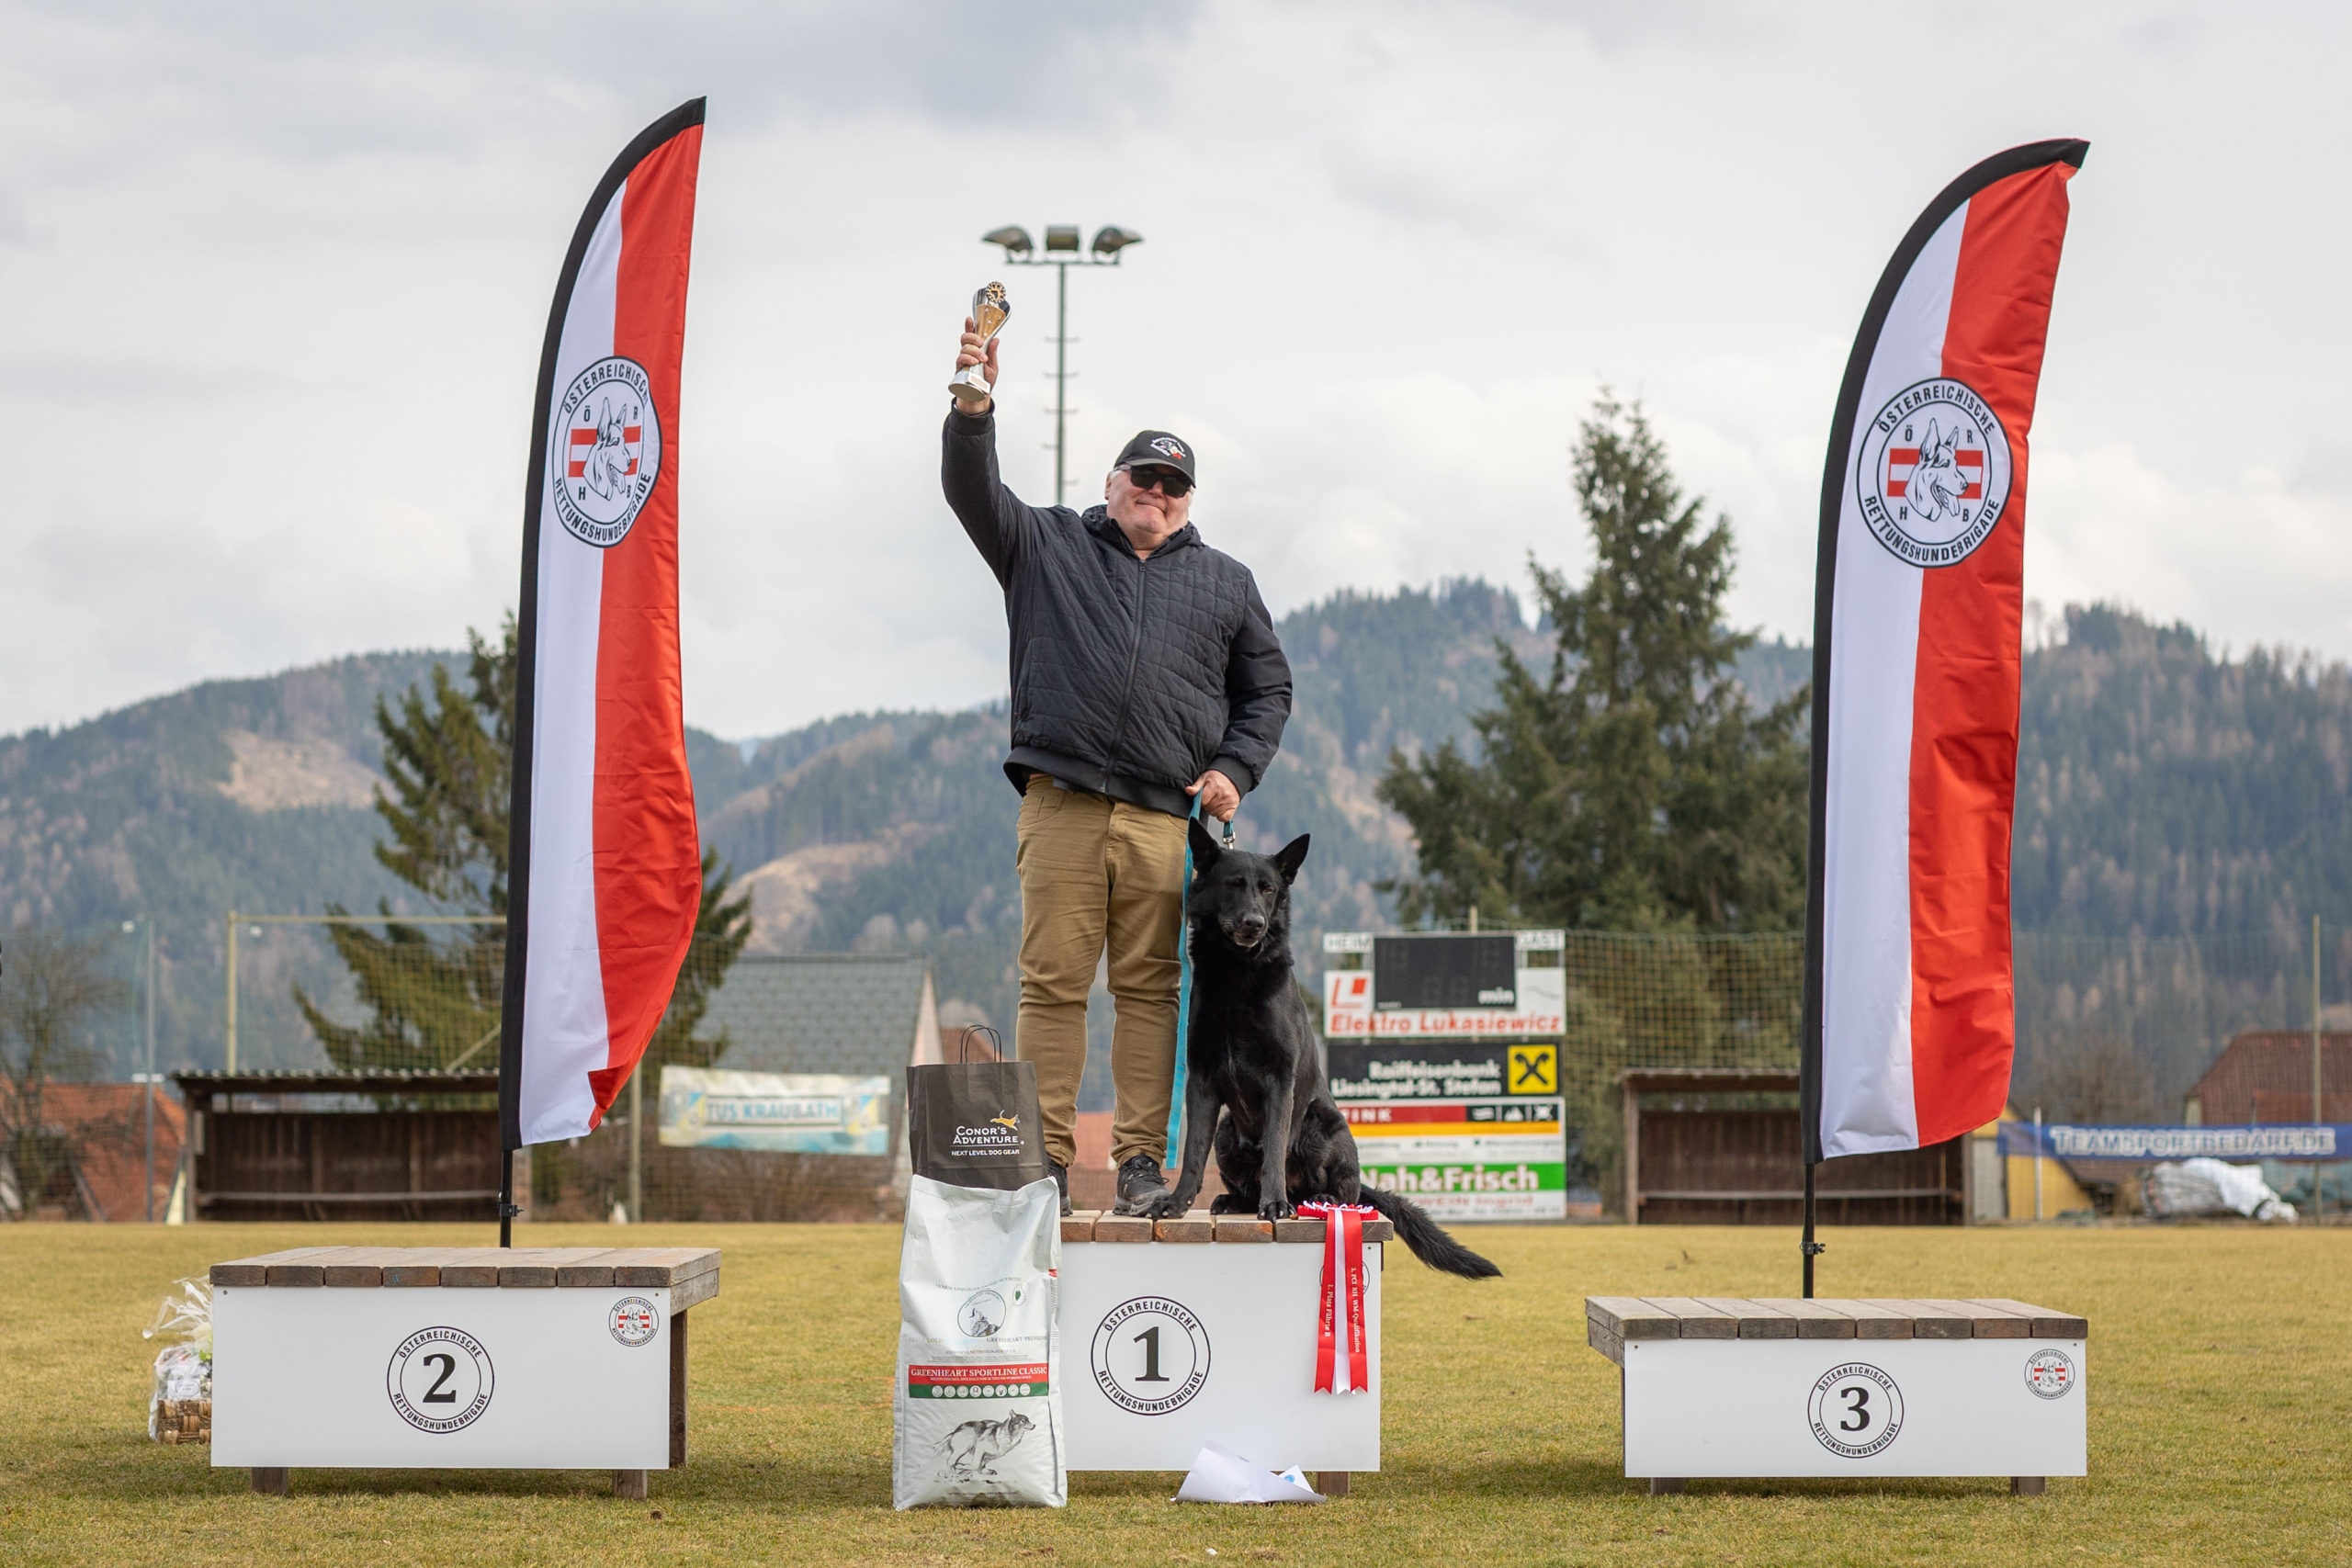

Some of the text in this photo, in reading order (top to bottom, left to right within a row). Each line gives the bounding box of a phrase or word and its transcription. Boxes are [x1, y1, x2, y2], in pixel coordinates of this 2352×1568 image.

[583, 405, 639, 423] Ö R
[1876, 384, 1996, 435] ÖSTERREICHISCHE
[1905, 424, 1973, 444] Ö R
[578, 484, 632, 501] H B
[555, 472, 651, 542] RETTUNGSHUNDEBRIGADE
[1899, 506, 1970, 523] H B
[1864, 495, 2000, 562] RETTUNGSHUNDEBRIGADE
[1478, 987, 1515, 1004] min
[1330, 1010, 1561, 1033] Elektro Lukasiewicz
[1369, 1059, 1501, 1080] Raiffeisenbank
[1444, 1078, 1501, 1097] Stefan
[956, 1125, 1007, 1136] CONOR'S
[1361, 1164, 1540, 1191] Nah&Frisch
[1102, 1301, 1198, 1332] ÖSTERREICHISCHE
[398, 1330, 482, 1359] ÖSTERREICHISCHE
[1133, 1325, 1170, 1382] 1
[423, 1353, 457, 1403] 2
[910, 1366, 1047, 1377] GREENHEART SPORTLINE CLASSIC
[1817, 1366, 1893, 1392] ÖSTERREICHISCHE
[1098, 1370, 1204, 1412] RETTUNGSHUNDEBRIGADE
[393, 1393, 488, 1430] RETTUNGSHUNDEBRIGADE
[1840, 1386, 1871, 1432] 3
[1813, 1421, 1899, 1456] RETTUNGSHUNDEBRIGADE
